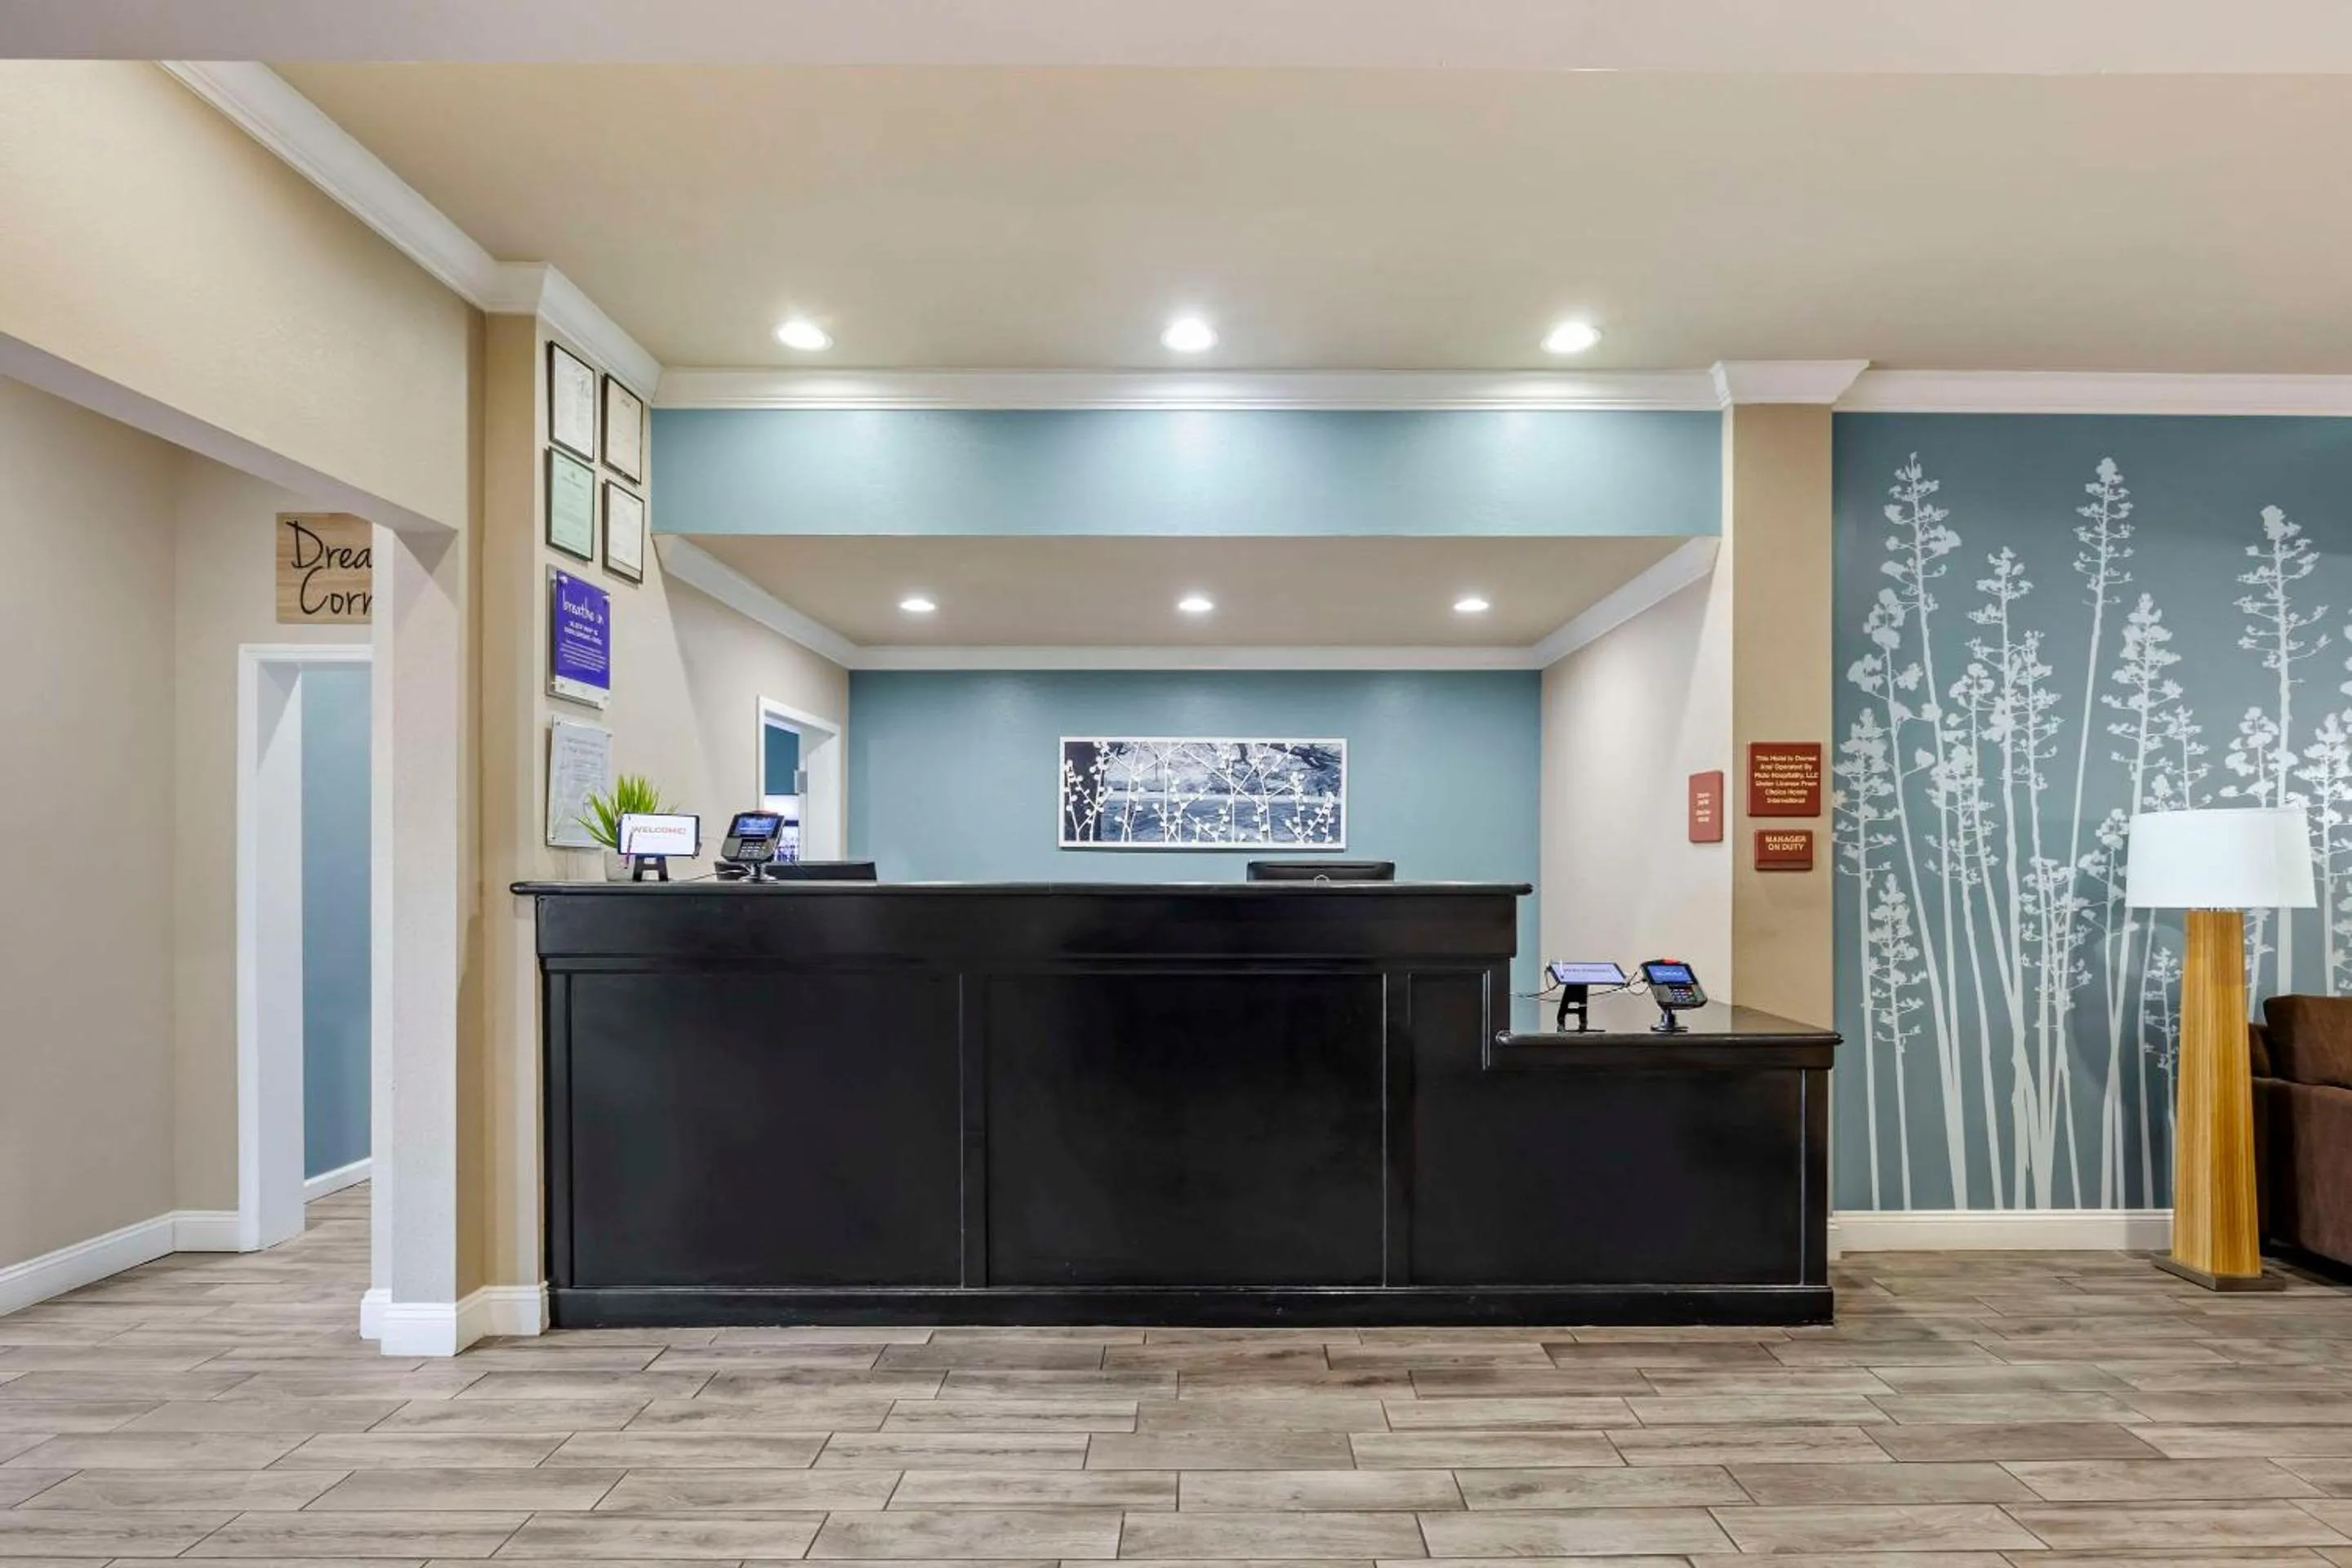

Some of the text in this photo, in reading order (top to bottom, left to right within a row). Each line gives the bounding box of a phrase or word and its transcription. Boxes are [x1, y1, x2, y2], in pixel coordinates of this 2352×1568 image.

[286, 520, 372, 570] Drea
[1765, 835, 1806, 843] MANAGER
[1768, 843, 1804, 851] ON DUTY
